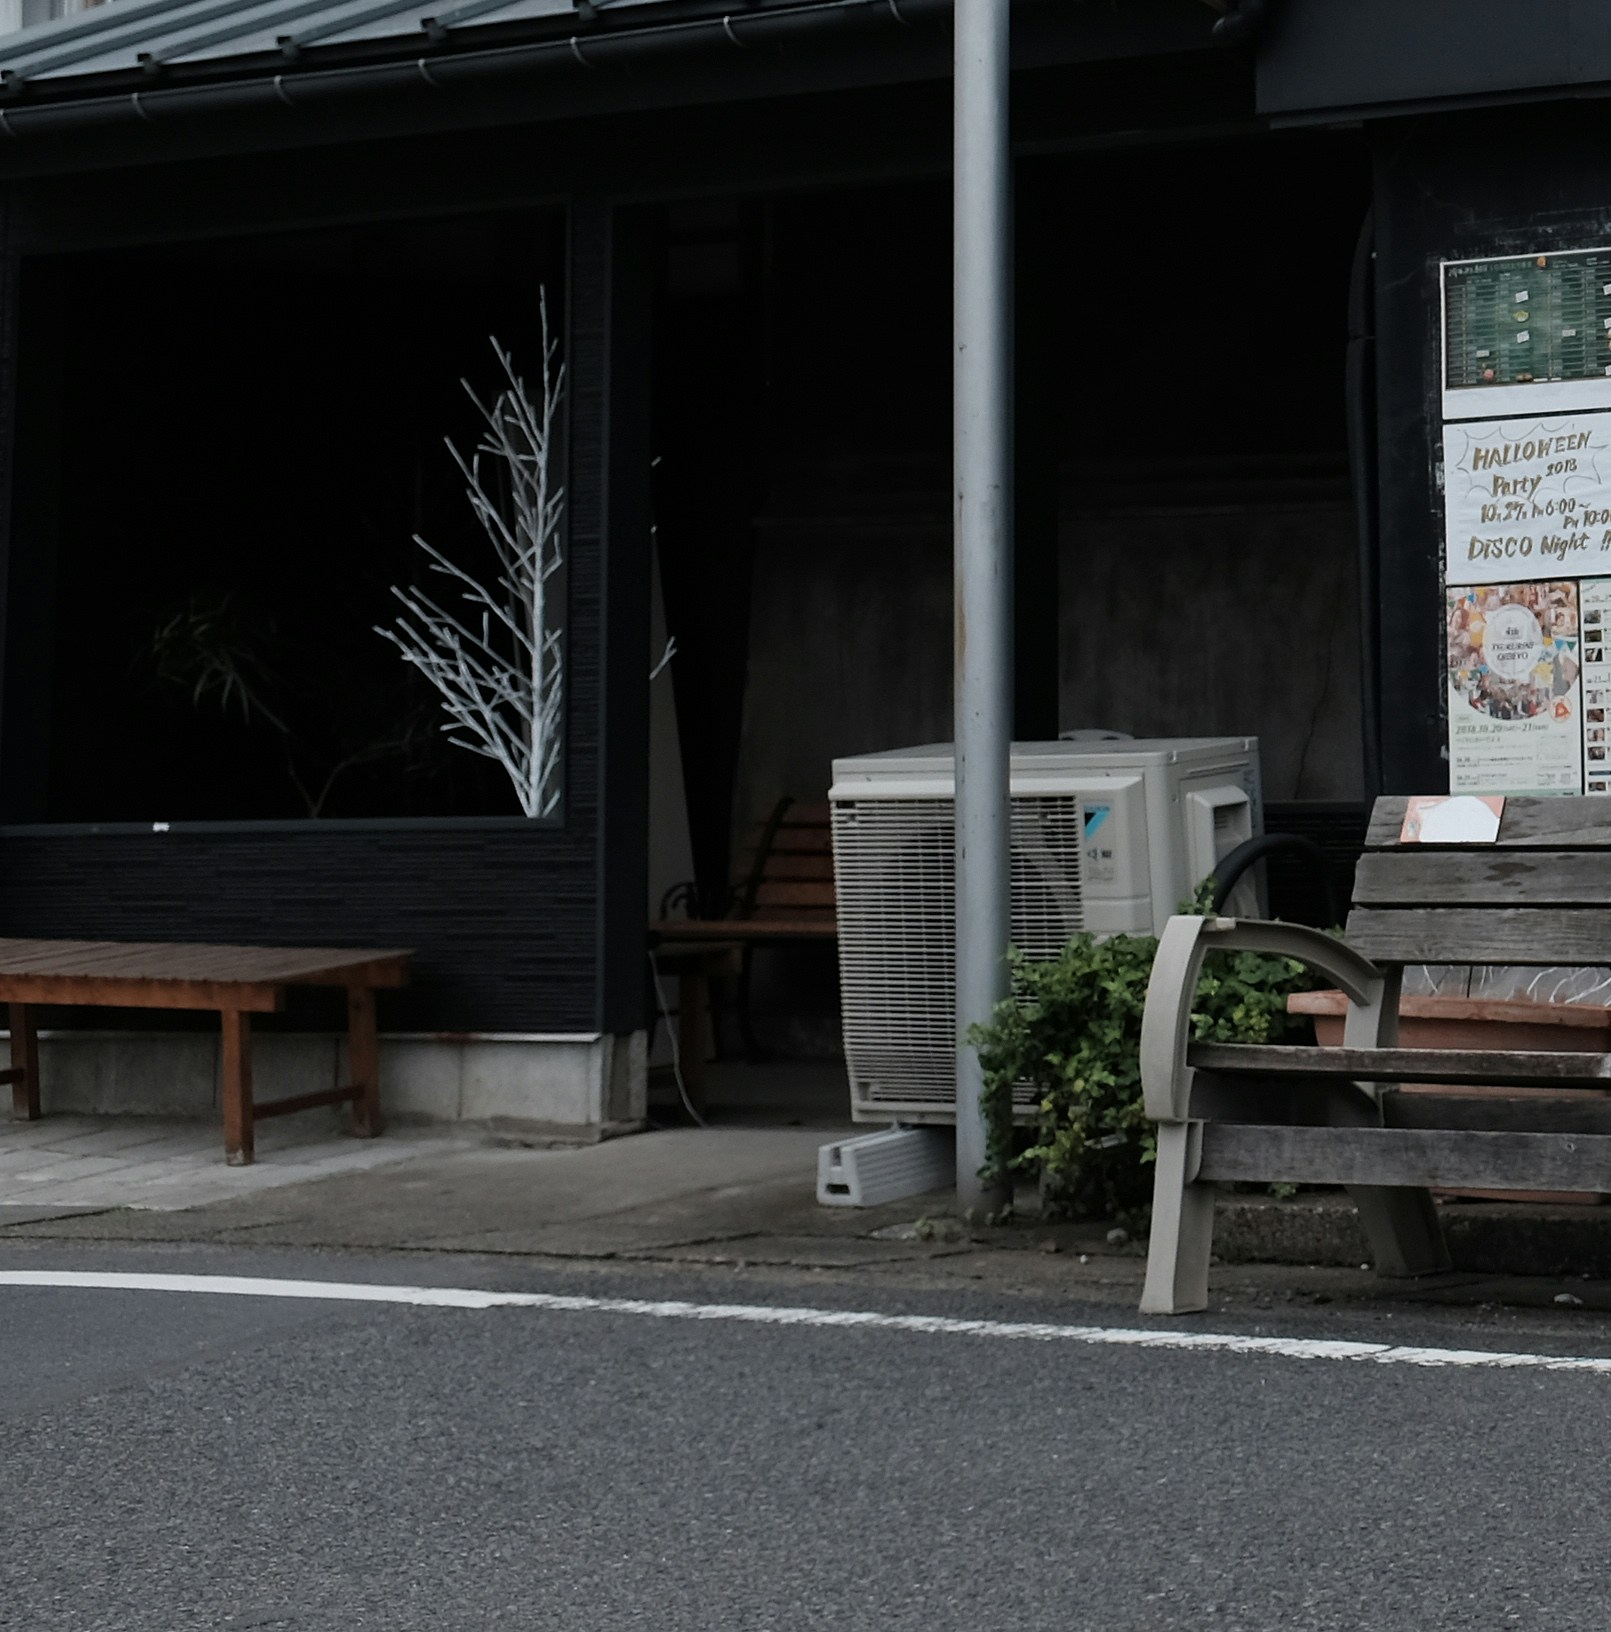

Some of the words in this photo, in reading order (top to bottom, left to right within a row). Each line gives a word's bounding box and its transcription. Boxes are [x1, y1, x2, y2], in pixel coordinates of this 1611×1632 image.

[1472, 430, 1592, 471] HALLOWEEN
[1493, 474, 1542, 500] Party
[1540, 532, 1590, 561] Night
